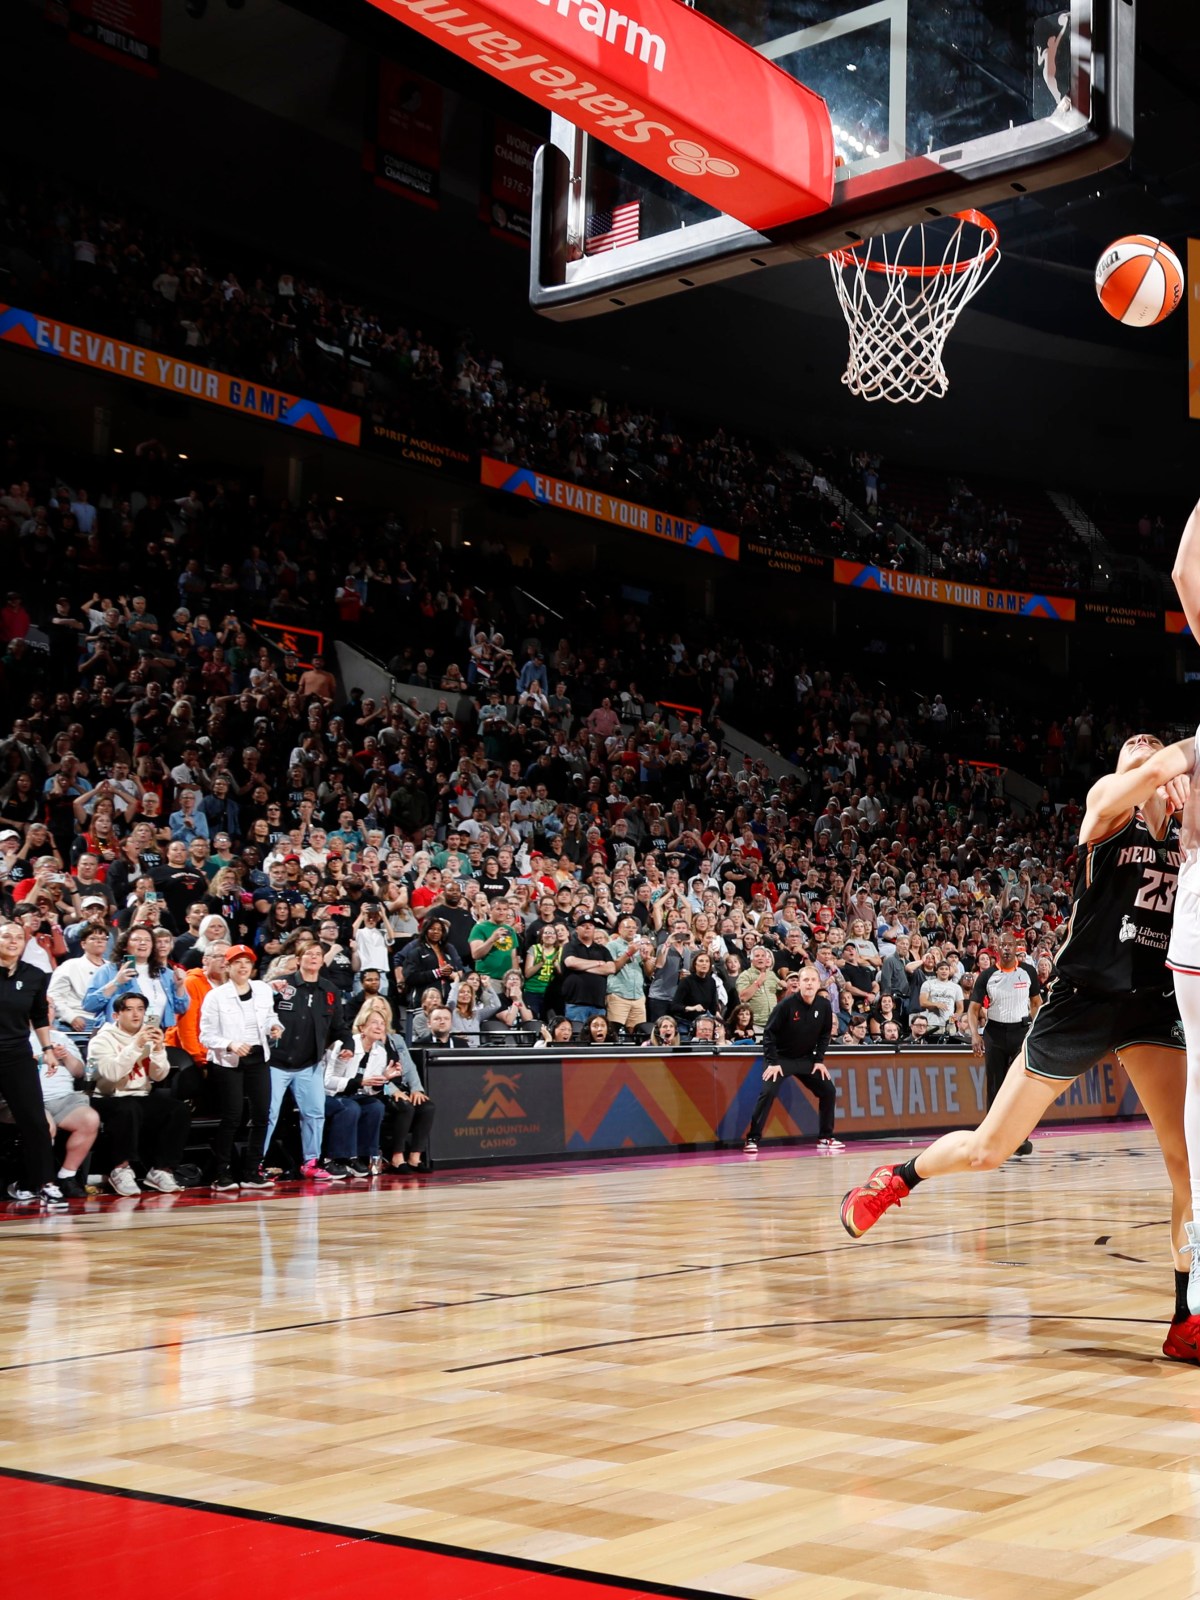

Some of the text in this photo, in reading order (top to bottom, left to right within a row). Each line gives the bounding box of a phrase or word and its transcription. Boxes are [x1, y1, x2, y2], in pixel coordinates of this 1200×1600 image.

[35, 320, 289, 419] ELEVATE YOUR GAME
[374, 427, 469, 462] SPIRIT MOUNTAIN
[402, 449, 442, 468] CASINO
[535, 476, 692, 542] ELEVATE YOUR GAME
[879, 571, 1025, 611] ELEVATE YOUR GAME
[1117, 846, 1156, 866] NEW
[1134, 868, 1178, 913] 23
[1134, 936, 1168, 950] Mutual
[1139, 926, 1169, 941] Liberty
[833, 1066, 940, 1118] ELEVATE
[454, 1124, 540, 1137] SPIRIT MOUNTAIN
[480, 1138, 517, 1149] CASINO
